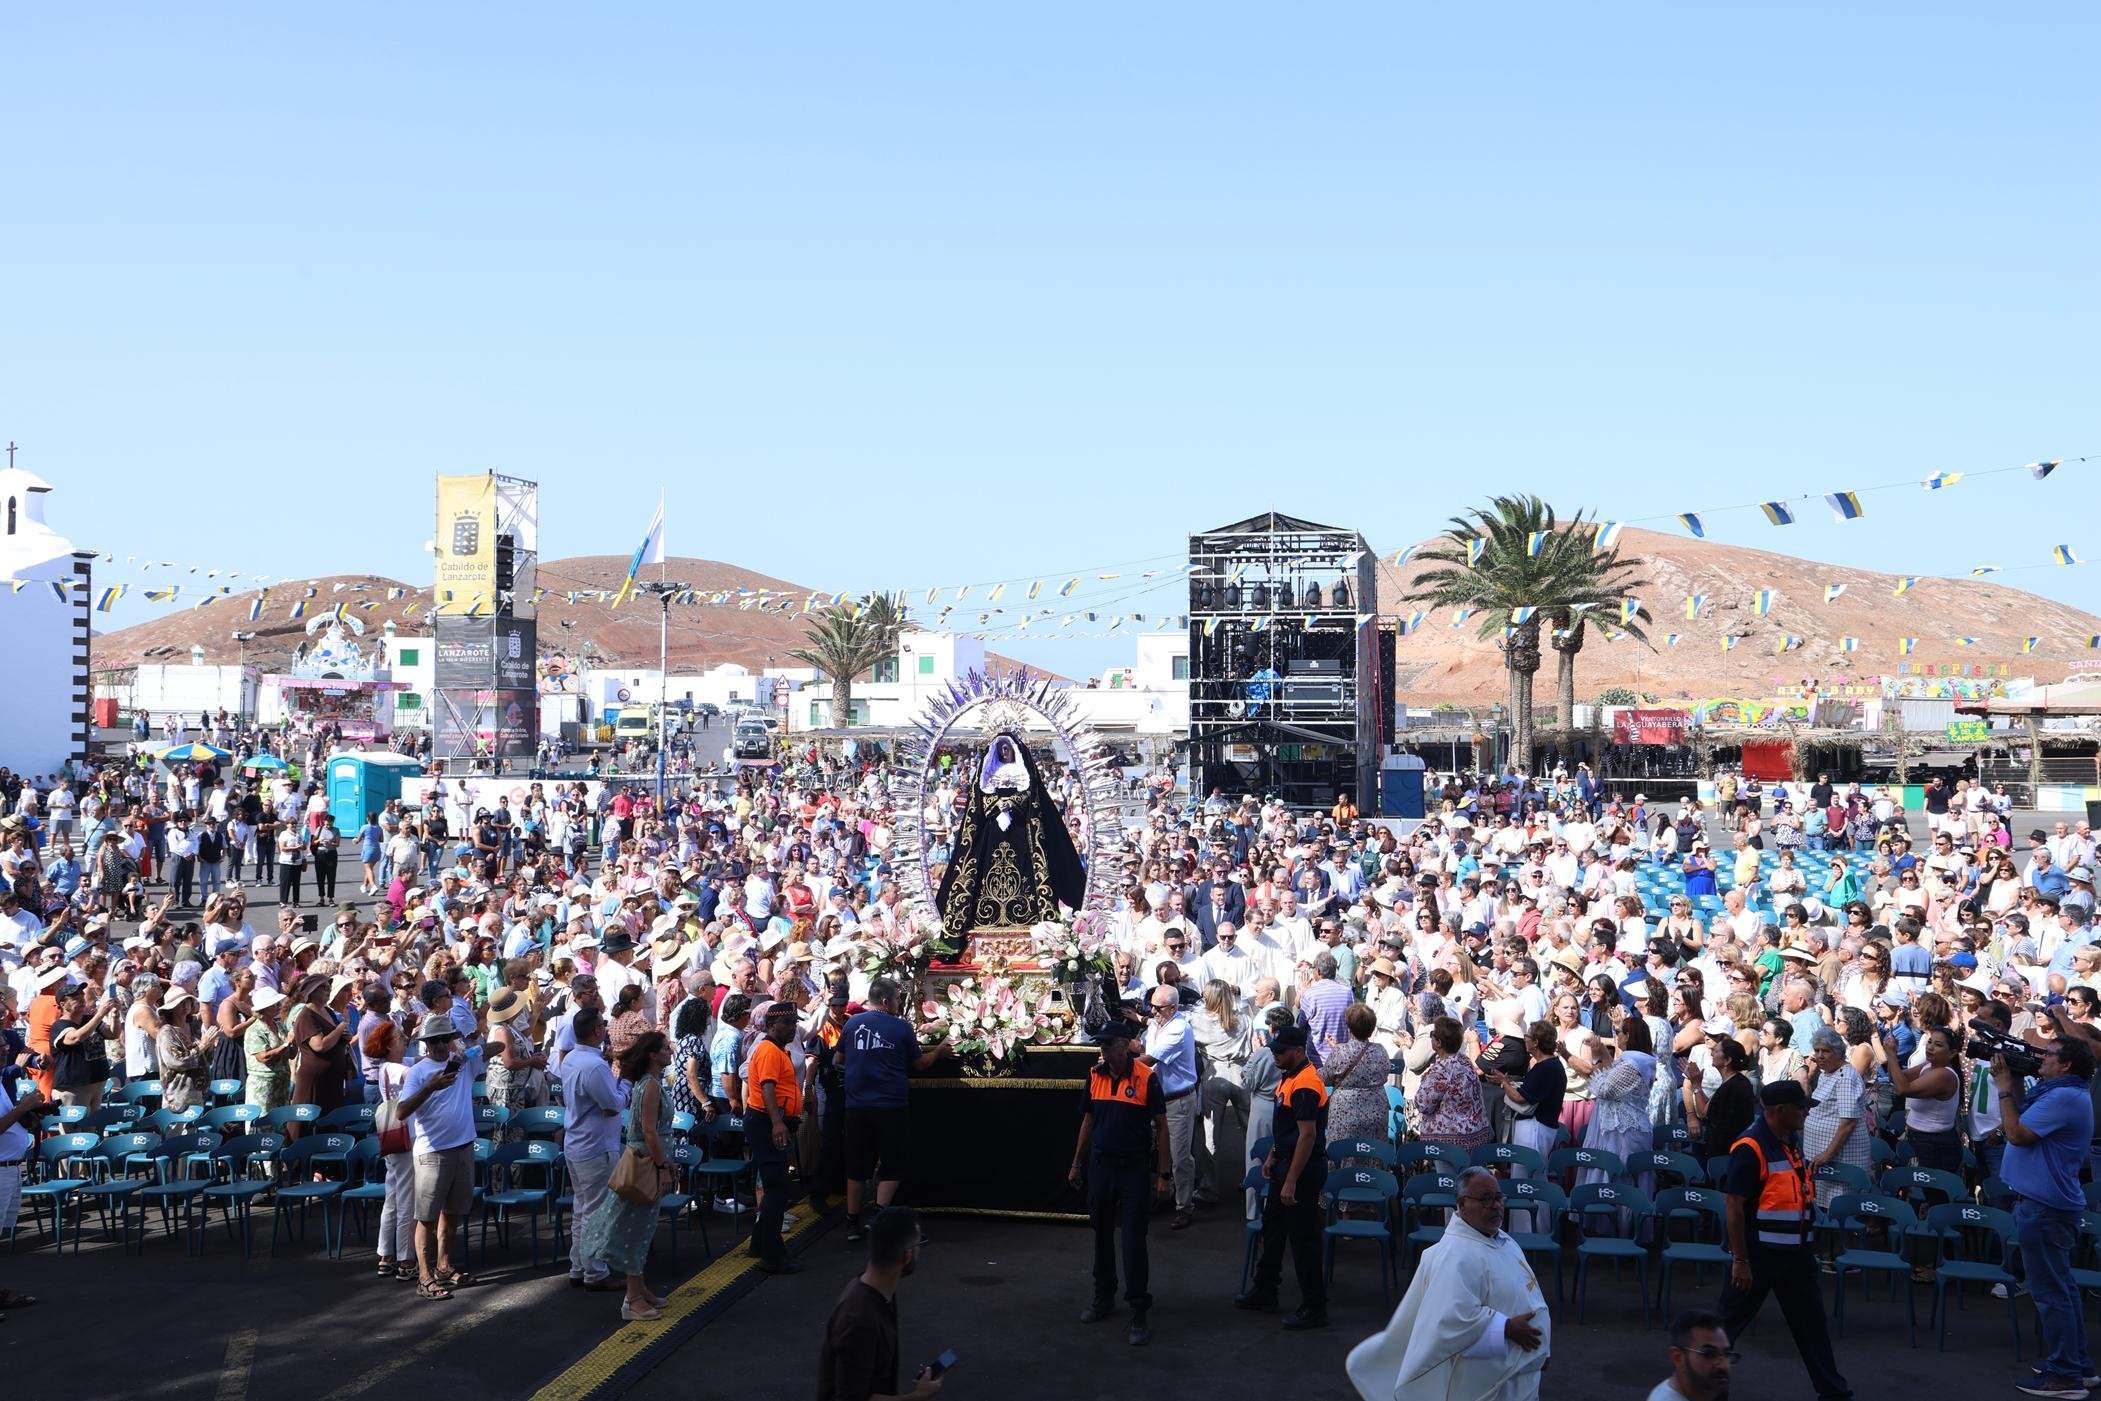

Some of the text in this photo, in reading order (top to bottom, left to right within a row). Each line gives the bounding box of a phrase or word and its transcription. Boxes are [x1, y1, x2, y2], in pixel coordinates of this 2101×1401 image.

[441, 562, 489, 571] Cabildo de
[442, 573, 487, 581] Lanzarote
[438, 649, 490, 657] LANZAROTE
